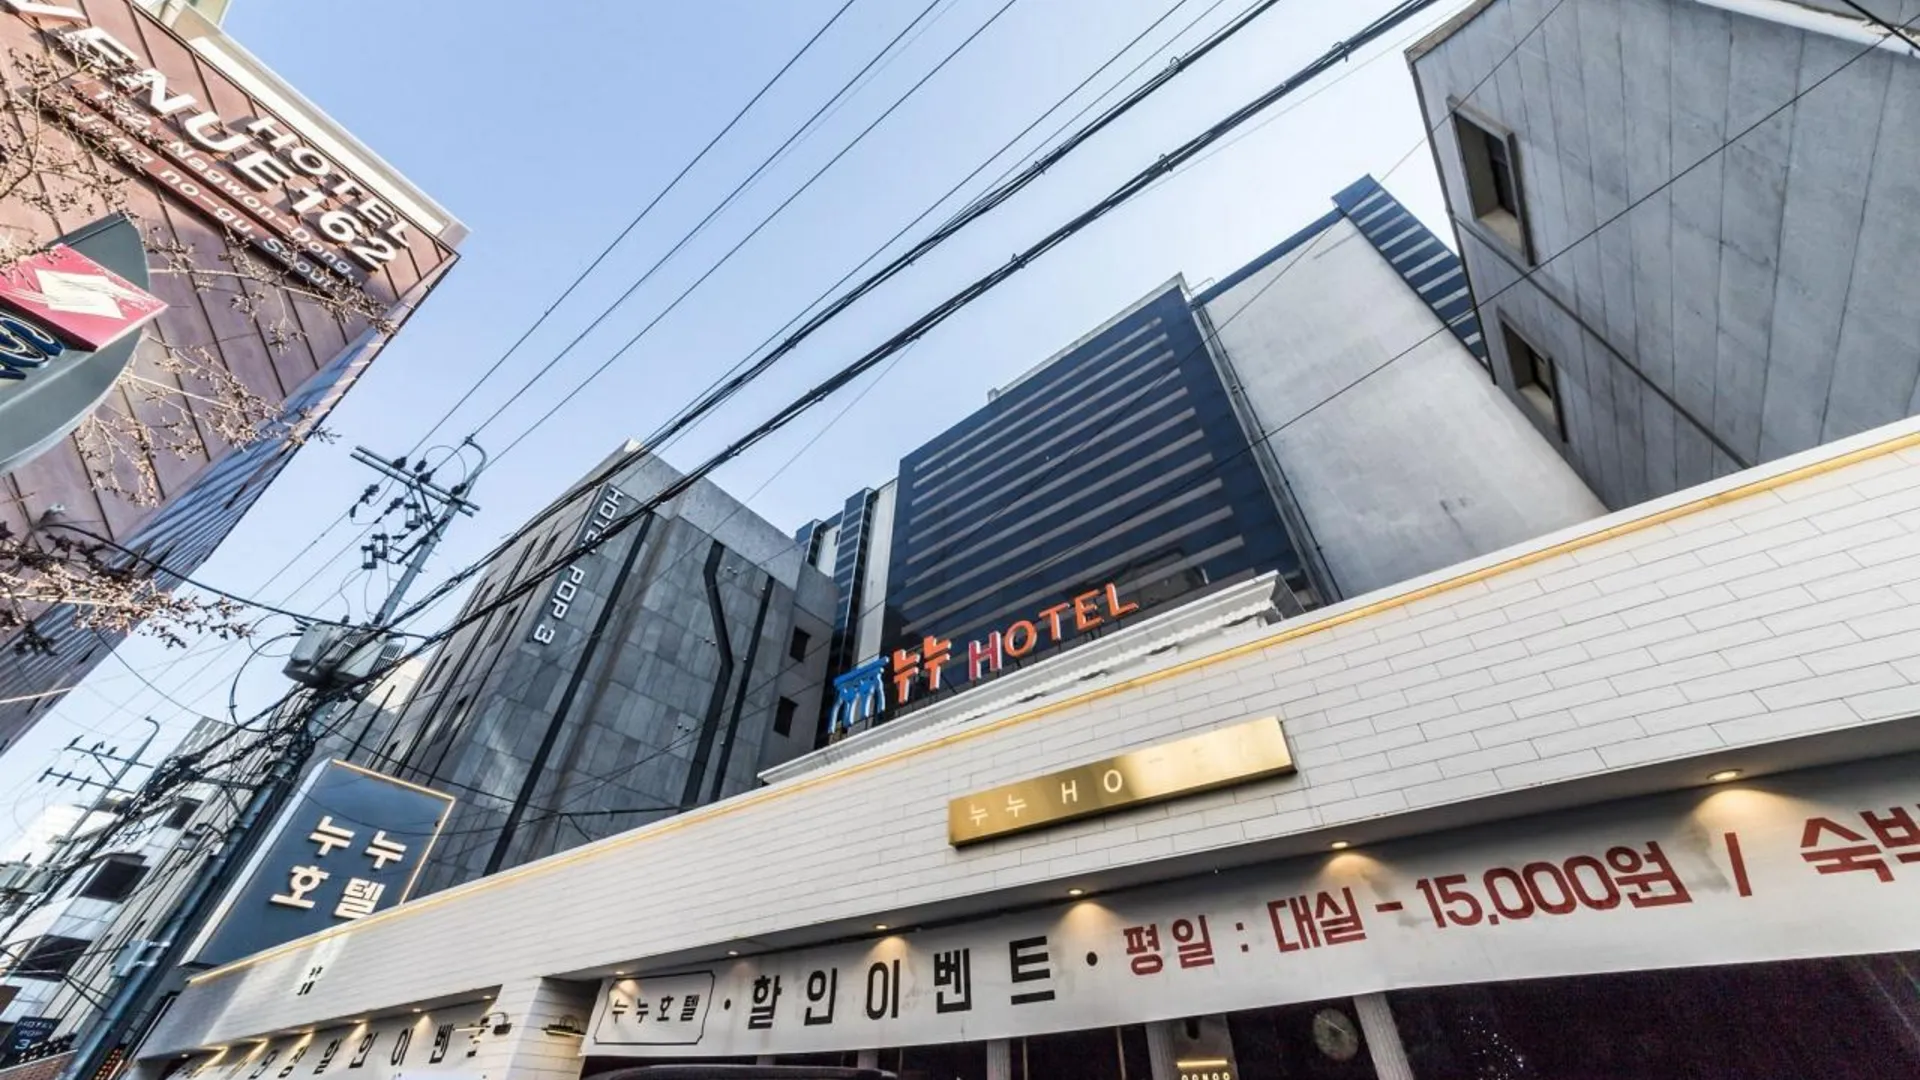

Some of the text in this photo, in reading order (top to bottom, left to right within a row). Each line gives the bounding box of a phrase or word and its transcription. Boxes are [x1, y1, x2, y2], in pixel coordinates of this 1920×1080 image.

[247, 116, 410, 249] HOTEL
[552, 564, 586, 620] POP
[533, 624, 556, 645] 3
[968, 582, 1140, 681] HOTEL
[309, 815, 407, 870] 누누
[270, 865, 386, 920] 호텔
[1123, 914, 1215, 976] 평일
[1267, 886, 1367, 953] 대실
